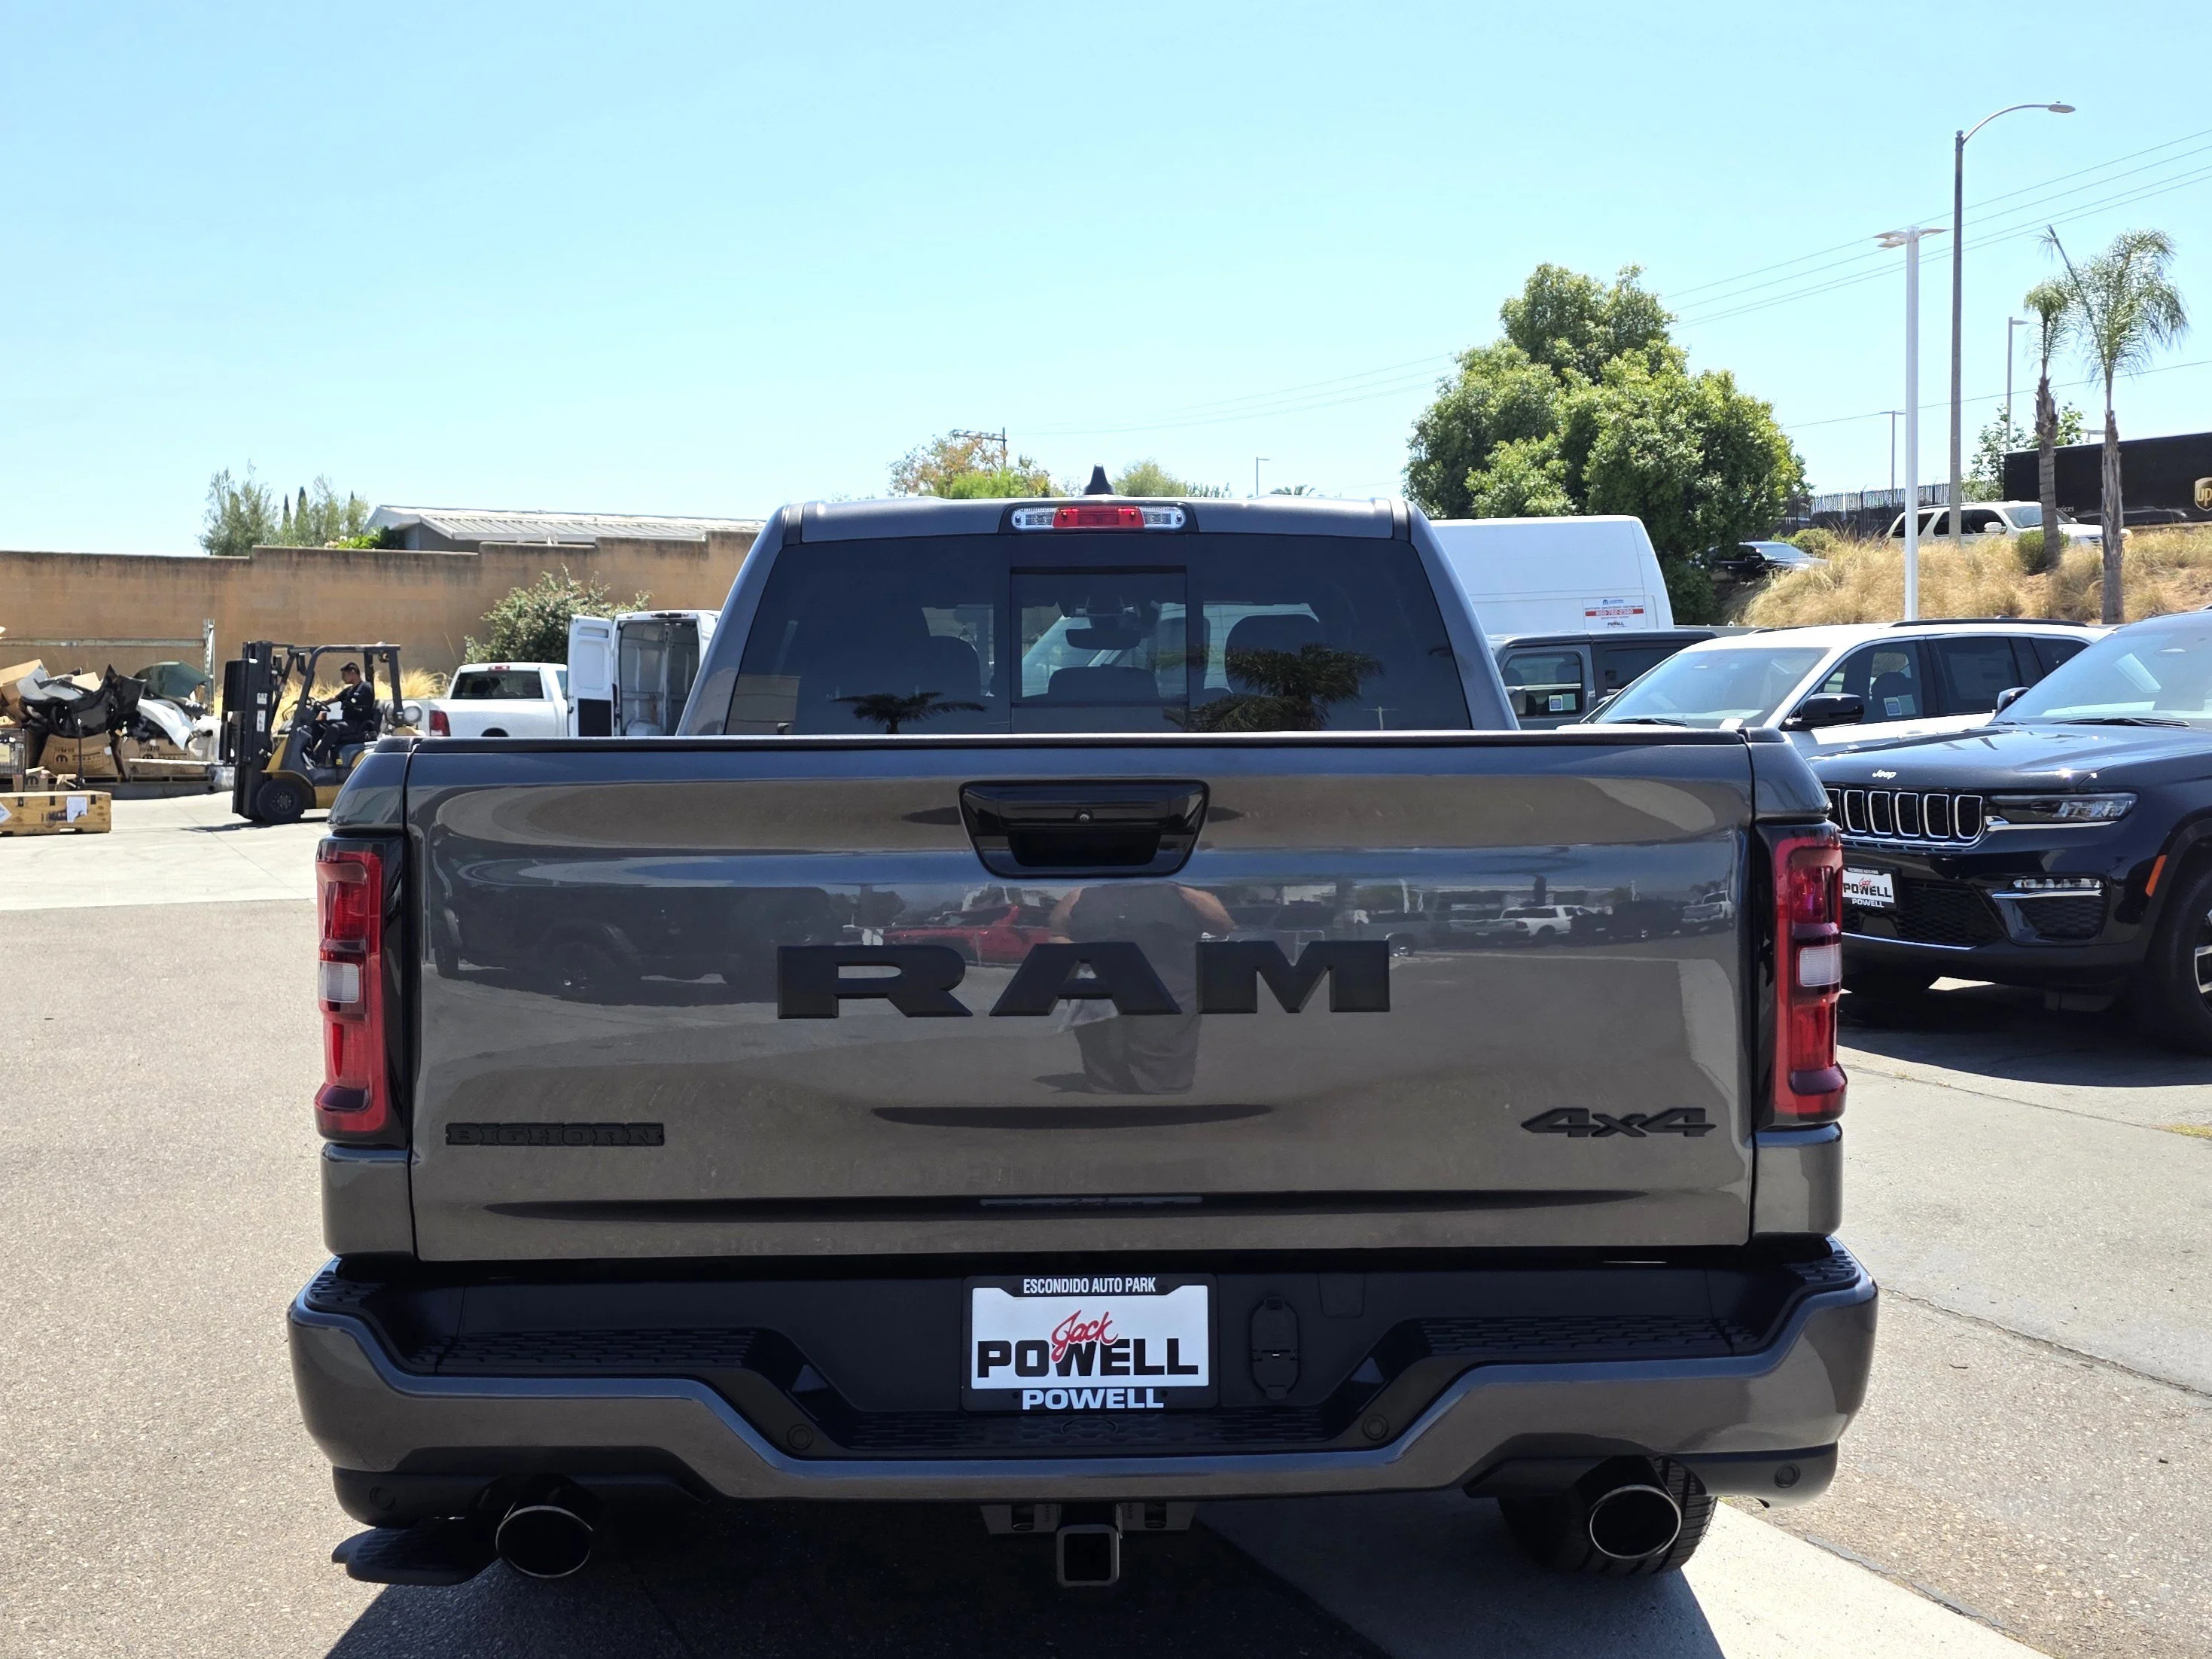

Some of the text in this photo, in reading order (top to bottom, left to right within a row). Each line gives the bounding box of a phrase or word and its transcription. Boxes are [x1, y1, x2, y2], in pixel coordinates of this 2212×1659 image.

[2197, 487, 2212, 506] up
[1872, 769, 1897, 779] Jeep
[1843, 883, 1892, 898] POWELL
[1852, 898, 1885, 908] POWELL
[777, 941, 1390, 1019] RAM
[1521, 1107, 1717, 1138] 4x4
[1023, 1276, 1156, 1295] ESCONDIDO AUTO PARK
[1051, 1309, 1119, 1363] Jack
[977, 1337, 1199, 1379] POWELL
[1022, 1388, 1165, 1410] POWELL
